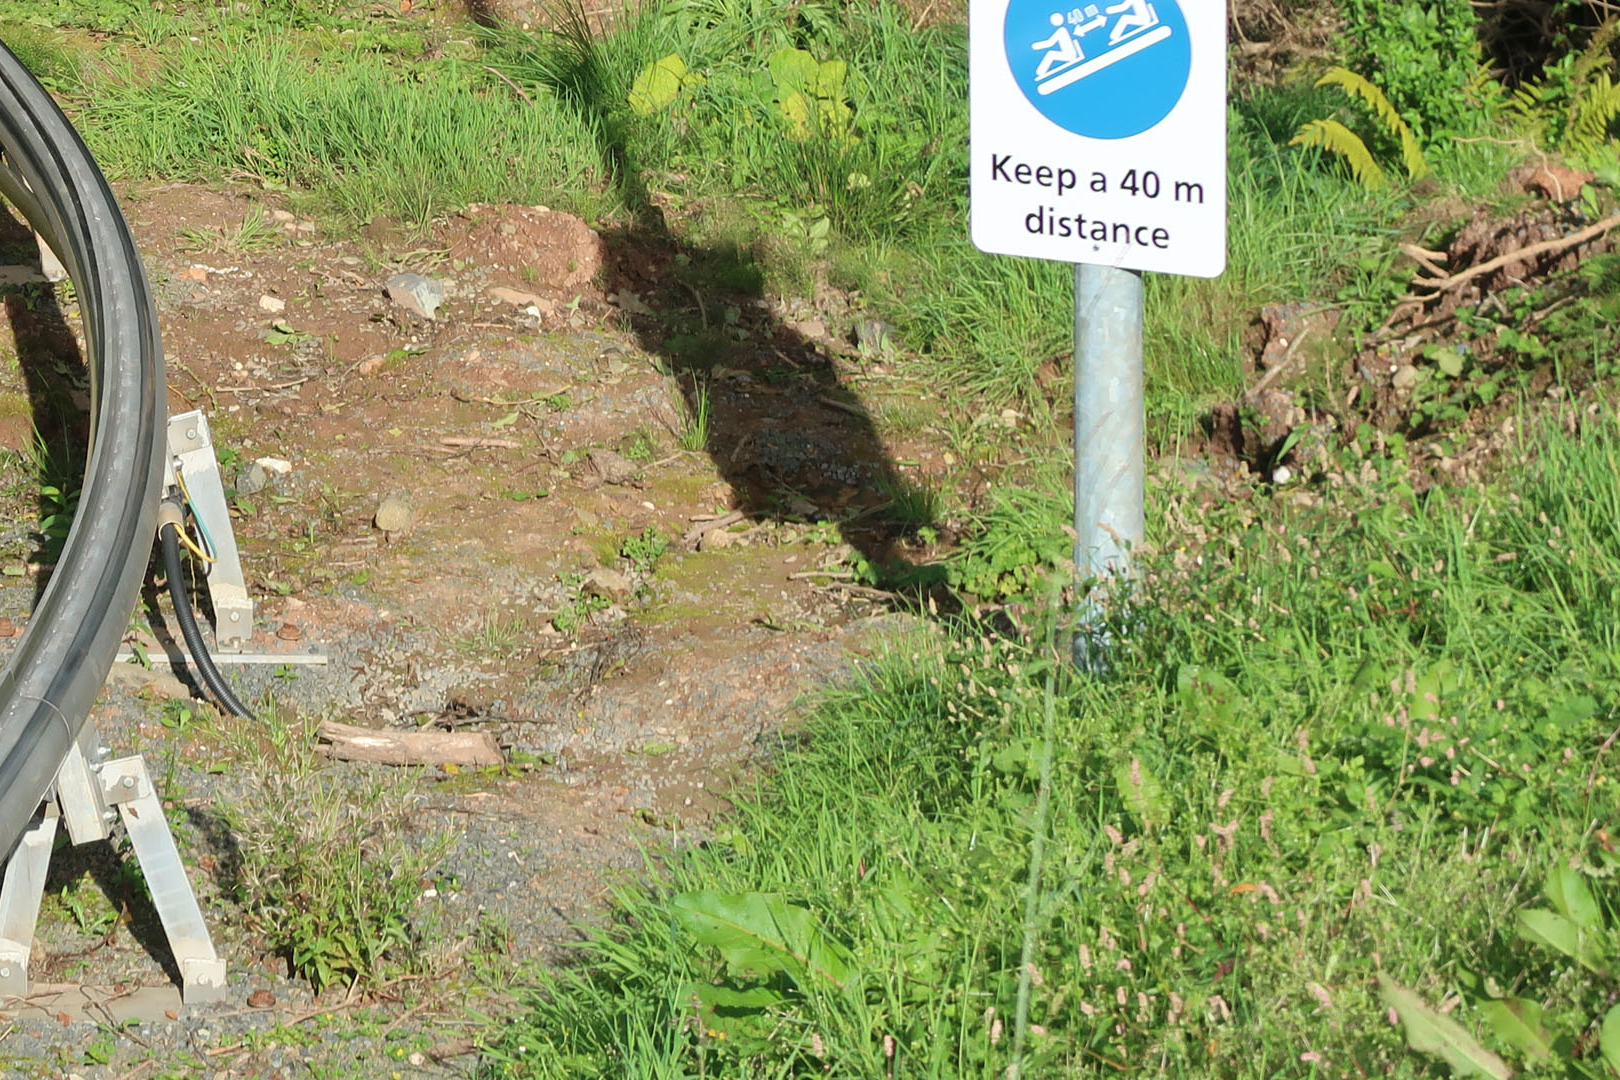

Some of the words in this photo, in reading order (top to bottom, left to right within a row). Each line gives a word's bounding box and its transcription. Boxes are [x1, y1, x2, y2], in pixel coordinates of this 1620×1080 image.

[991, 153, 1077, 197] Keep
[1089, 171, 1107, 193] a
[1120, 168, 1160, 199] 40
[1174, 180, 1204, 204] m
[1024, 204, 1170, 250] distance
